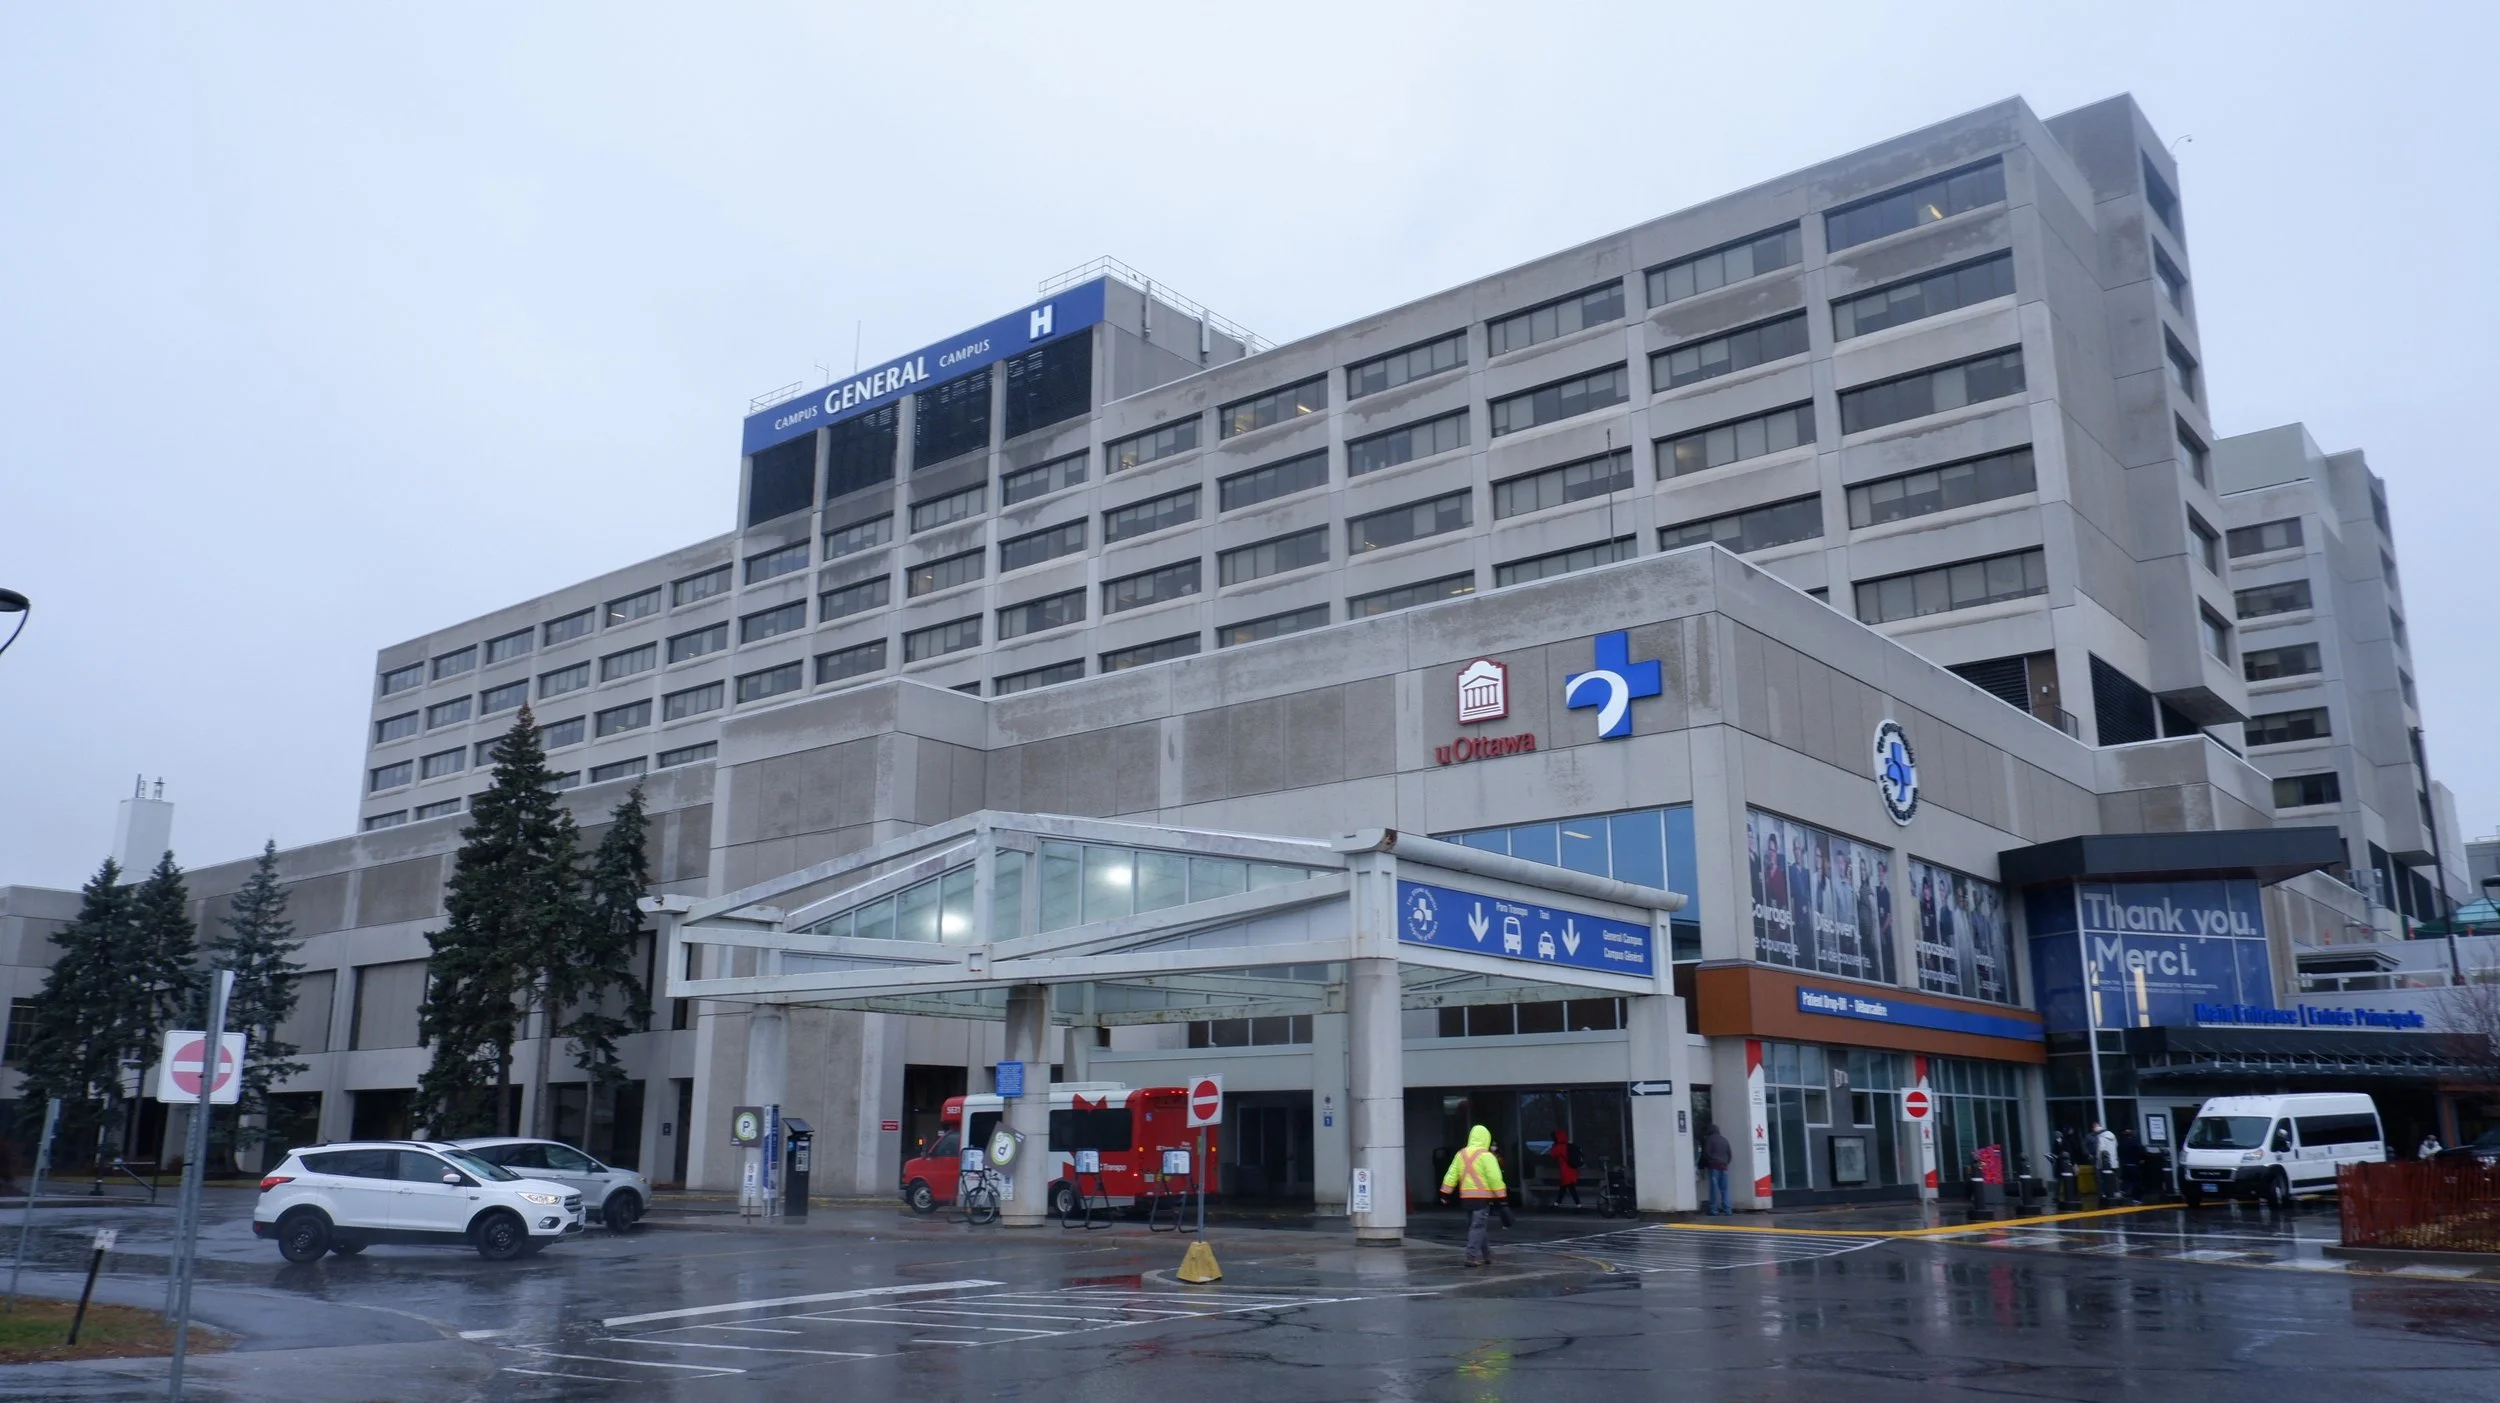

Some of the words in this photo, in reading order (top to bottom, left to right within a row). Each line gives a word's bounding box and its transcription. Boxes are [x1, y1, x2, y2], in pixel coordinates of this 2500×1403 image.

[1030, 304, 1053, 339] H
[774, 405, 818, 431] CAMPUS
[824, 356, 930, 415] GENERAL
[940, 339, 990, 367] CAMPUS
[1435, 733, 1536, 765] uOttawa
[2084, 893, 2186, 932] Thank
[2192, 909, 2257, 944] you.
[2094, 937, 2197, 976] Merci.
[2194, 1003, 2232, 1024] Main
[2233, 1004, 2298, 1025] Entrance
[2355, 1007, 2425, 1031] Principale
